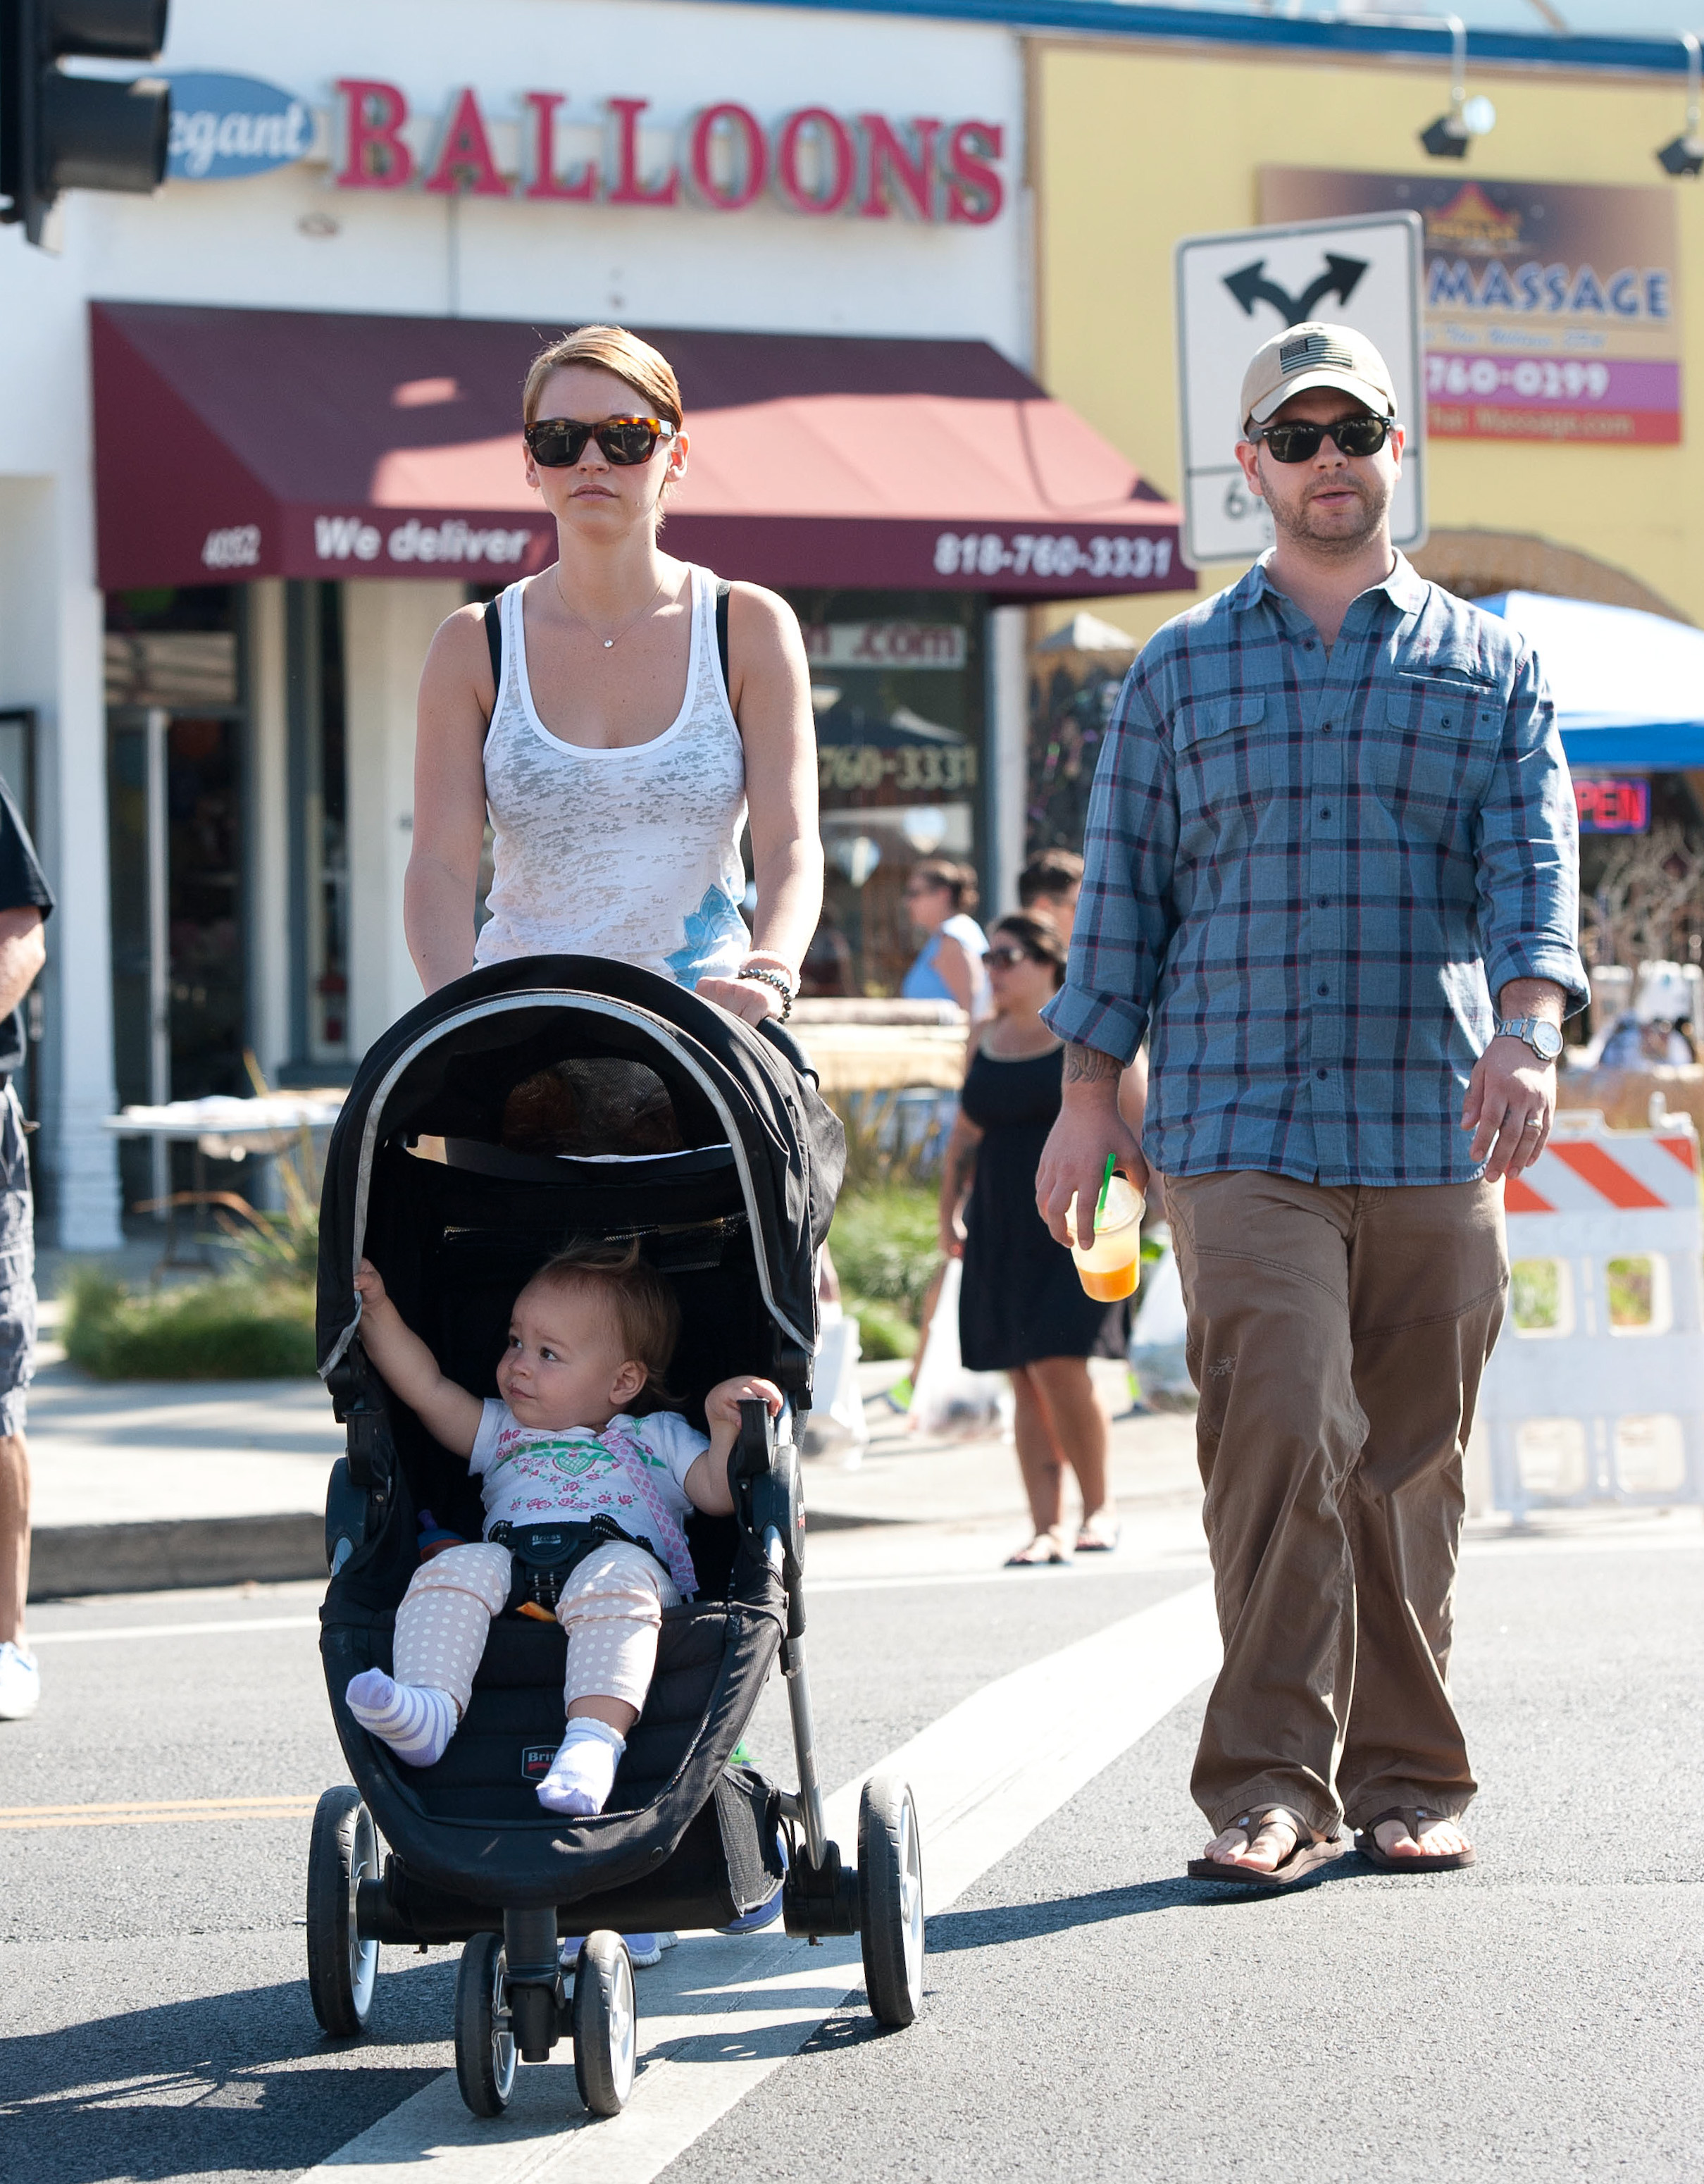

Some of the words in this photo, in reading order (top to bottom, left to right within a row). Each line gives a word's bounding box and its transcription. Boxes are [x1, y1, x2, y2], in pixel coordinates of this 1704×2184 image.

[334, 77, 1007, 225] BALLOONS
[1428, 259, 1670, 318] MASSAGE
[314, 515, 381, 561] We
[933, 531, 1173, 578] 818-760-3331
